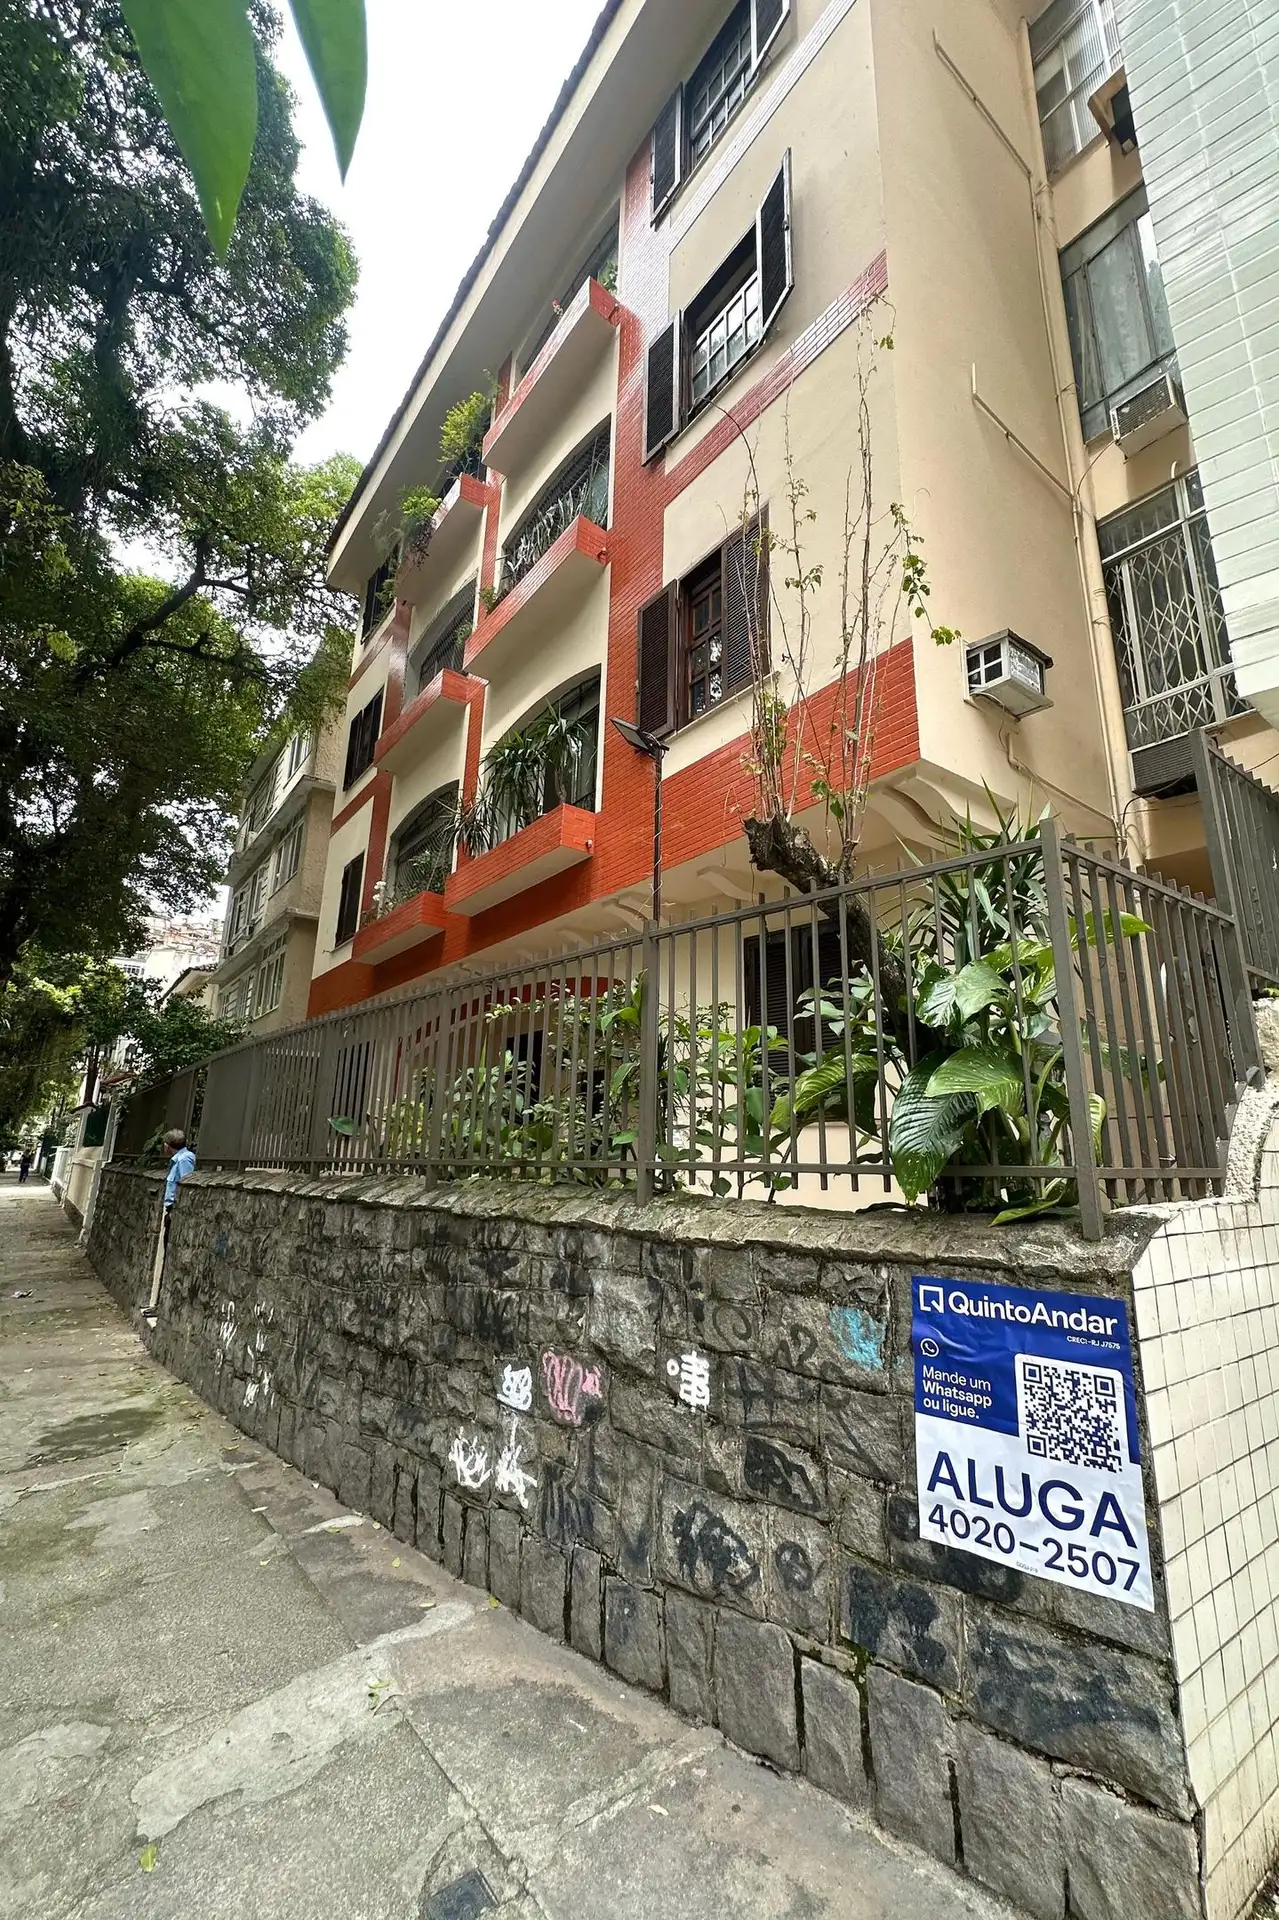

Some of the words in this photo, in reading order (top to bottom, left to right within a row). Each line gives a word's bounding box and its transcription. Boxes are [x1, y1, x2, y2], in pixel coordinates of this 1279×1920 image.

[948, 1290, 1118, 1336] QuintoAndar
[1066, 1335, 1100, 1347] CRECI-RJ
[1101, 1341, 1121, 1350] J7575
[922, 1365, 967, 1386] Mande
[969, 1377, 991, 1391] um
[922, 1380, 992, 1408] Whatsapp
[923, 1398, 941, 1410] ou
[942, 1400, 980, 1419] ligue.
[927, 1451, 1137, 1549] ALUGA
[928, 1503, 1140, 1592] 4020-2507
